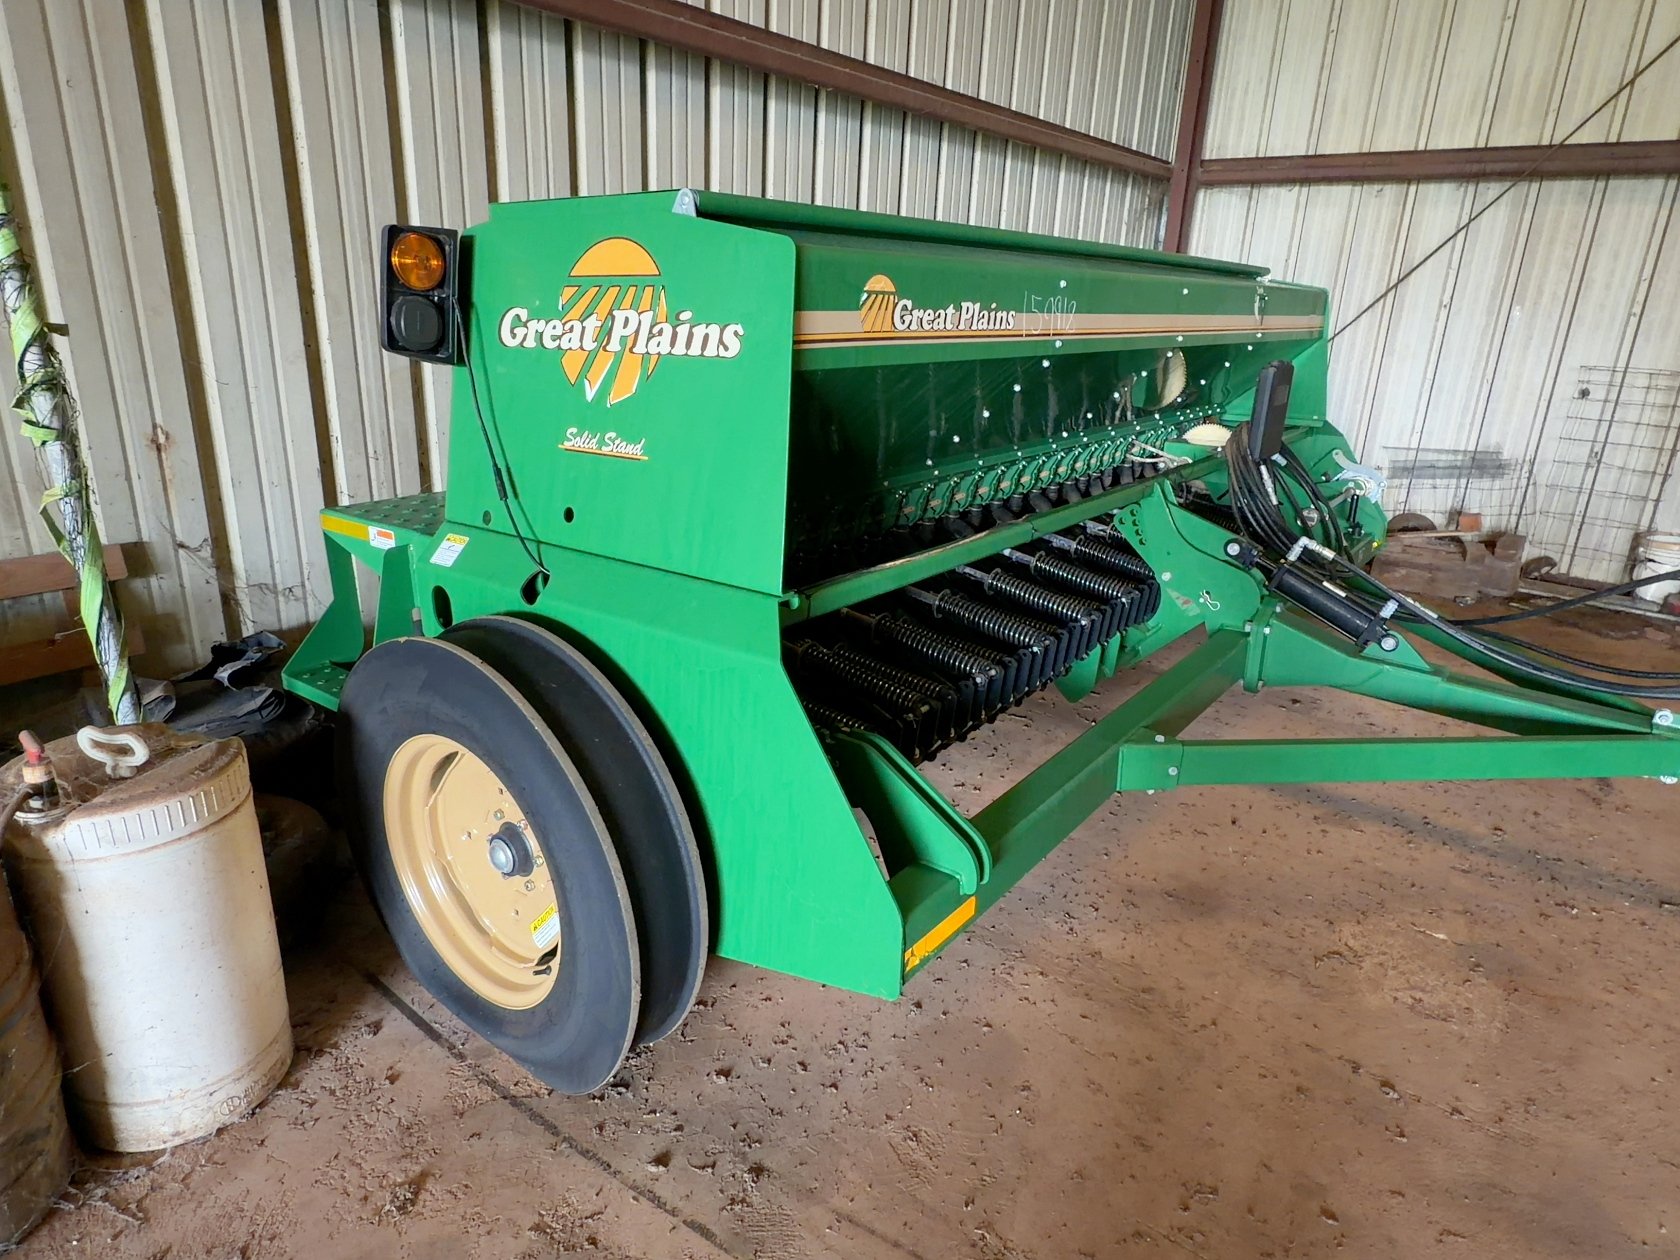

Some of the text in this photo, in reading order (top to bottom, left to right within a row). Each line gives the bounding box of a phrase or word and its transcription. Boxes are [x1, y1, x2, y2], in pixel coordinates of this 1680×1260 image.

[893, 299, 1016, 331] Great Plains
[498, 307, 745, 358] Great Plains
[563, 427, 645, 455] Solid Stand
